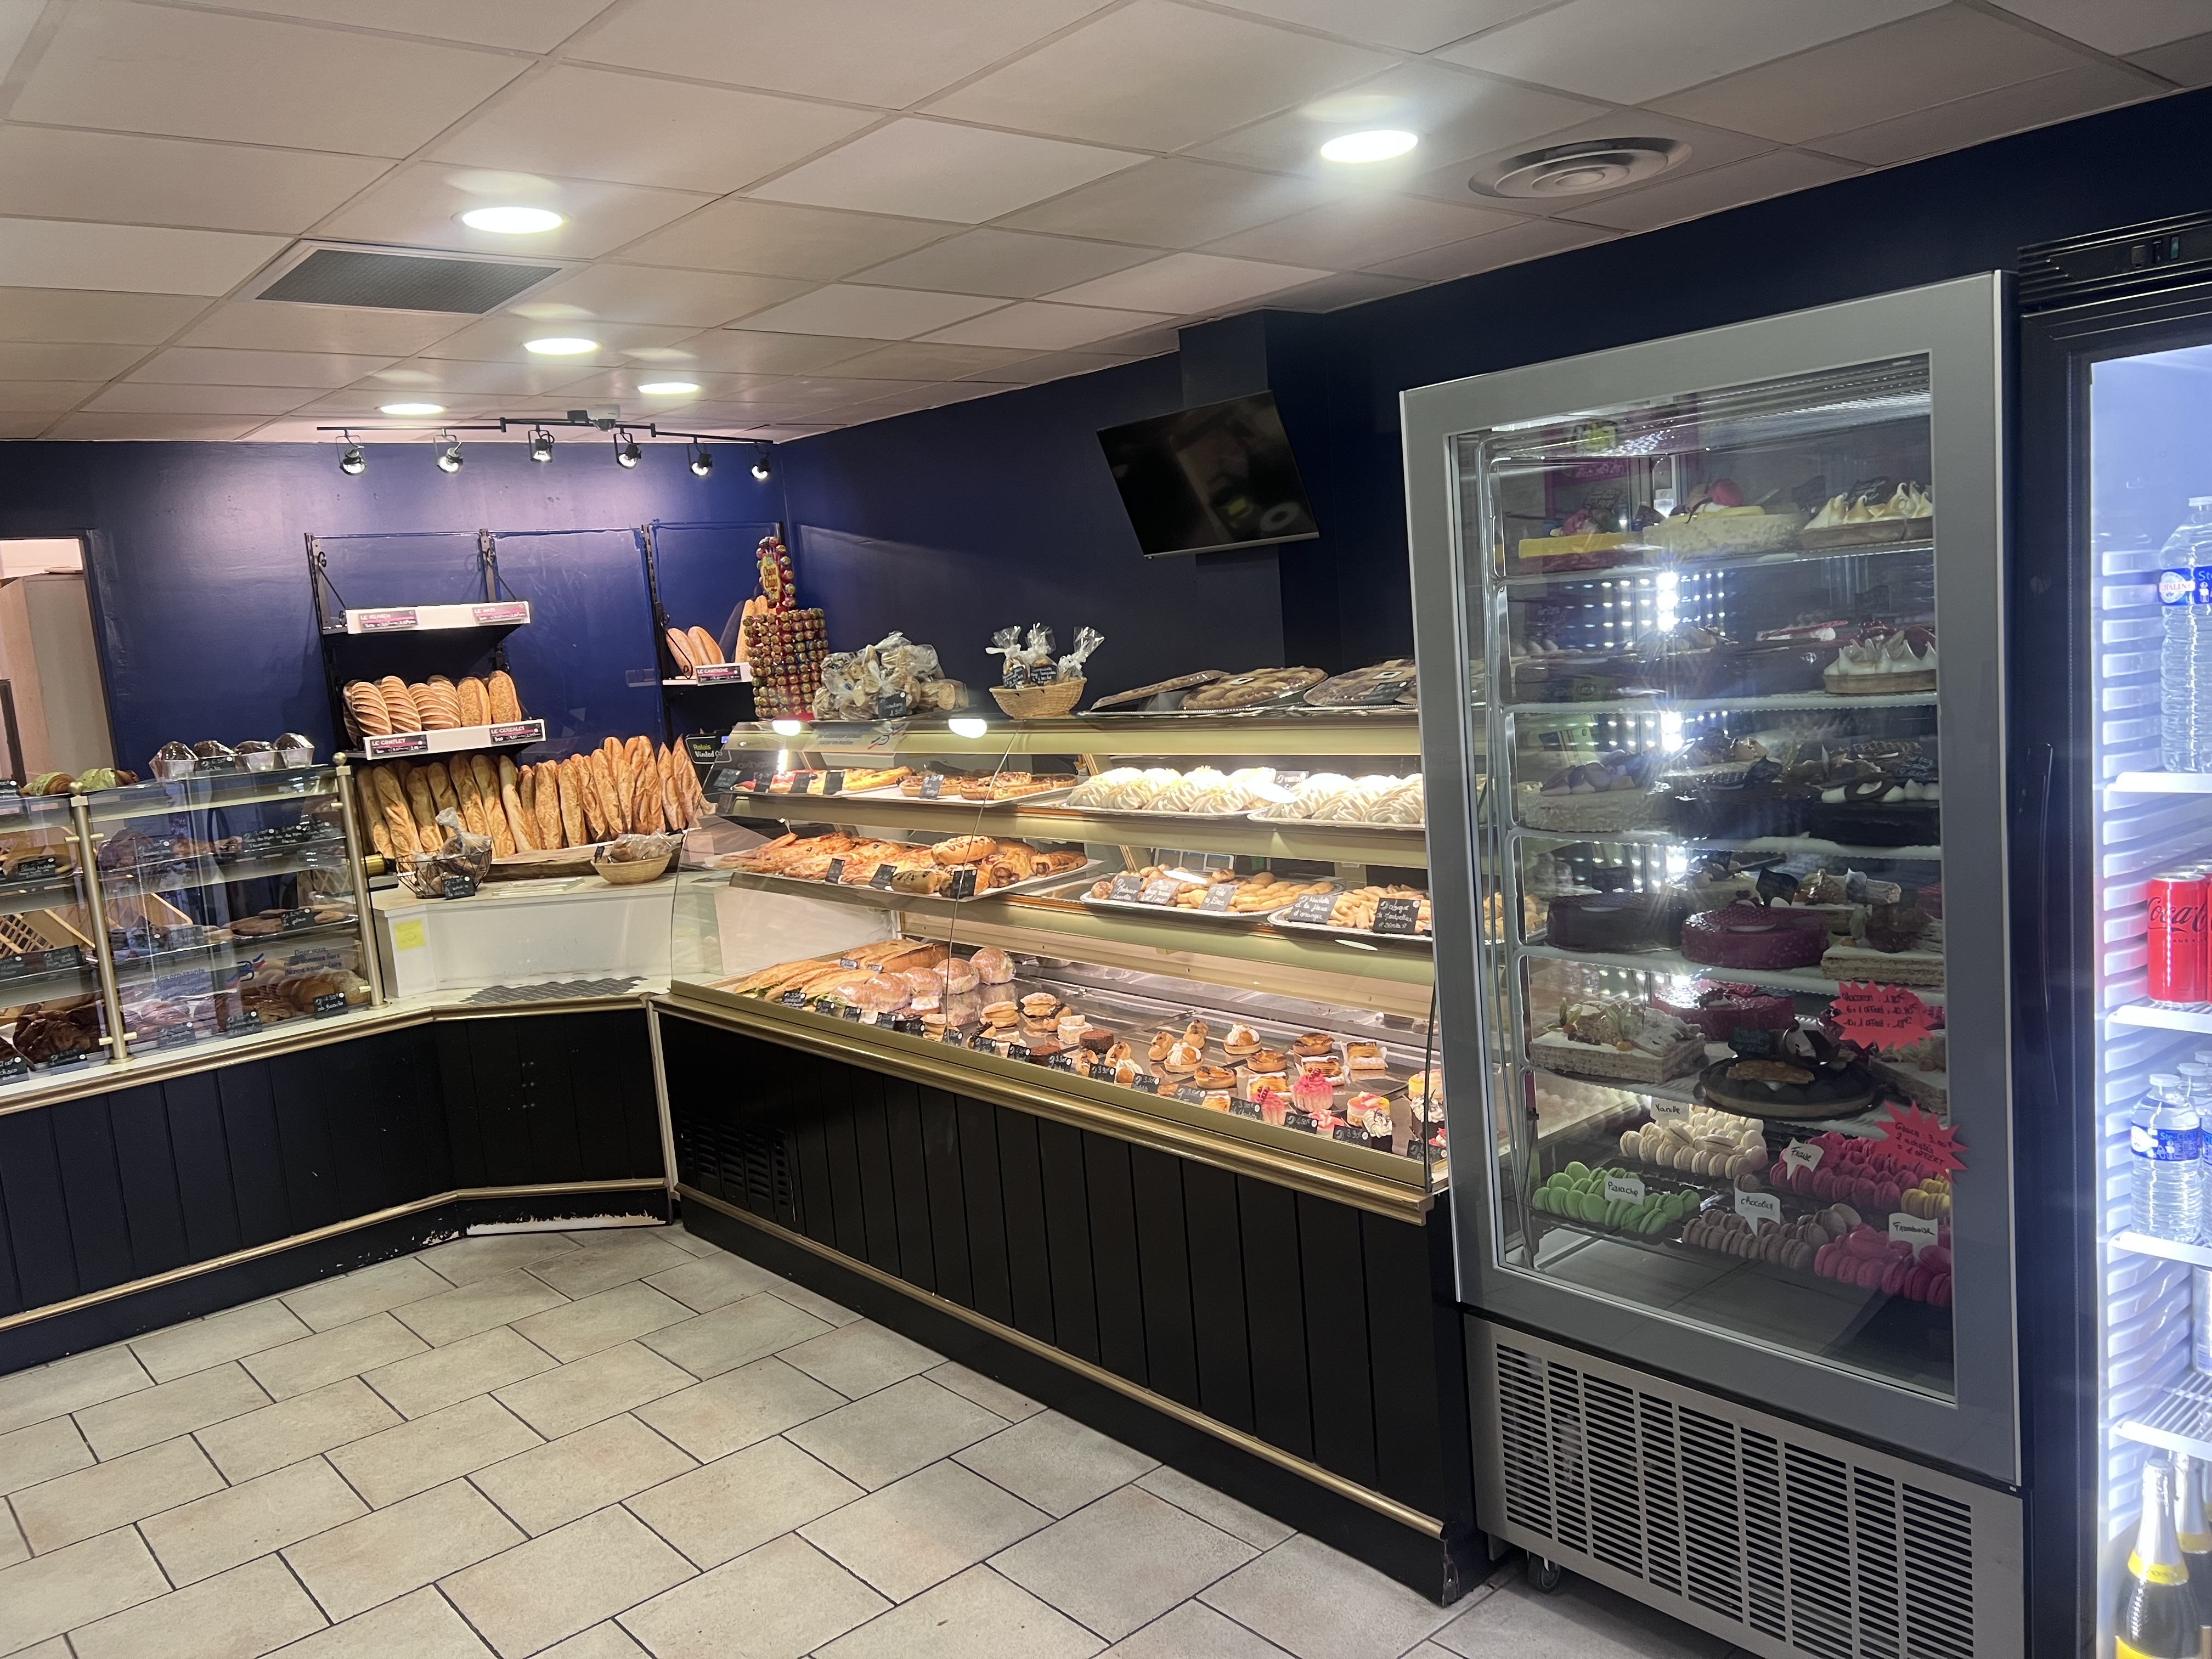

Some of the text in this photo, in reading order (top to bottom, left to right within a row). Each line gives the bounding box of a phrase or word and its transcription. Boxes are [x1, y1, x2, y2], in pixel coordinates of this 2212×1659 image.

[1655, 1103, 1680, 1114] Vanille
[1895, 1122, 1920, 1137] Glace
[1895, 1132, 1902, 1141] 2
[1791, 1146, 1812, 1162] Fraise
[1607, 1181, 1639, 1197] Pistache
[1740, 1196, 1773, 1211] chocolat
